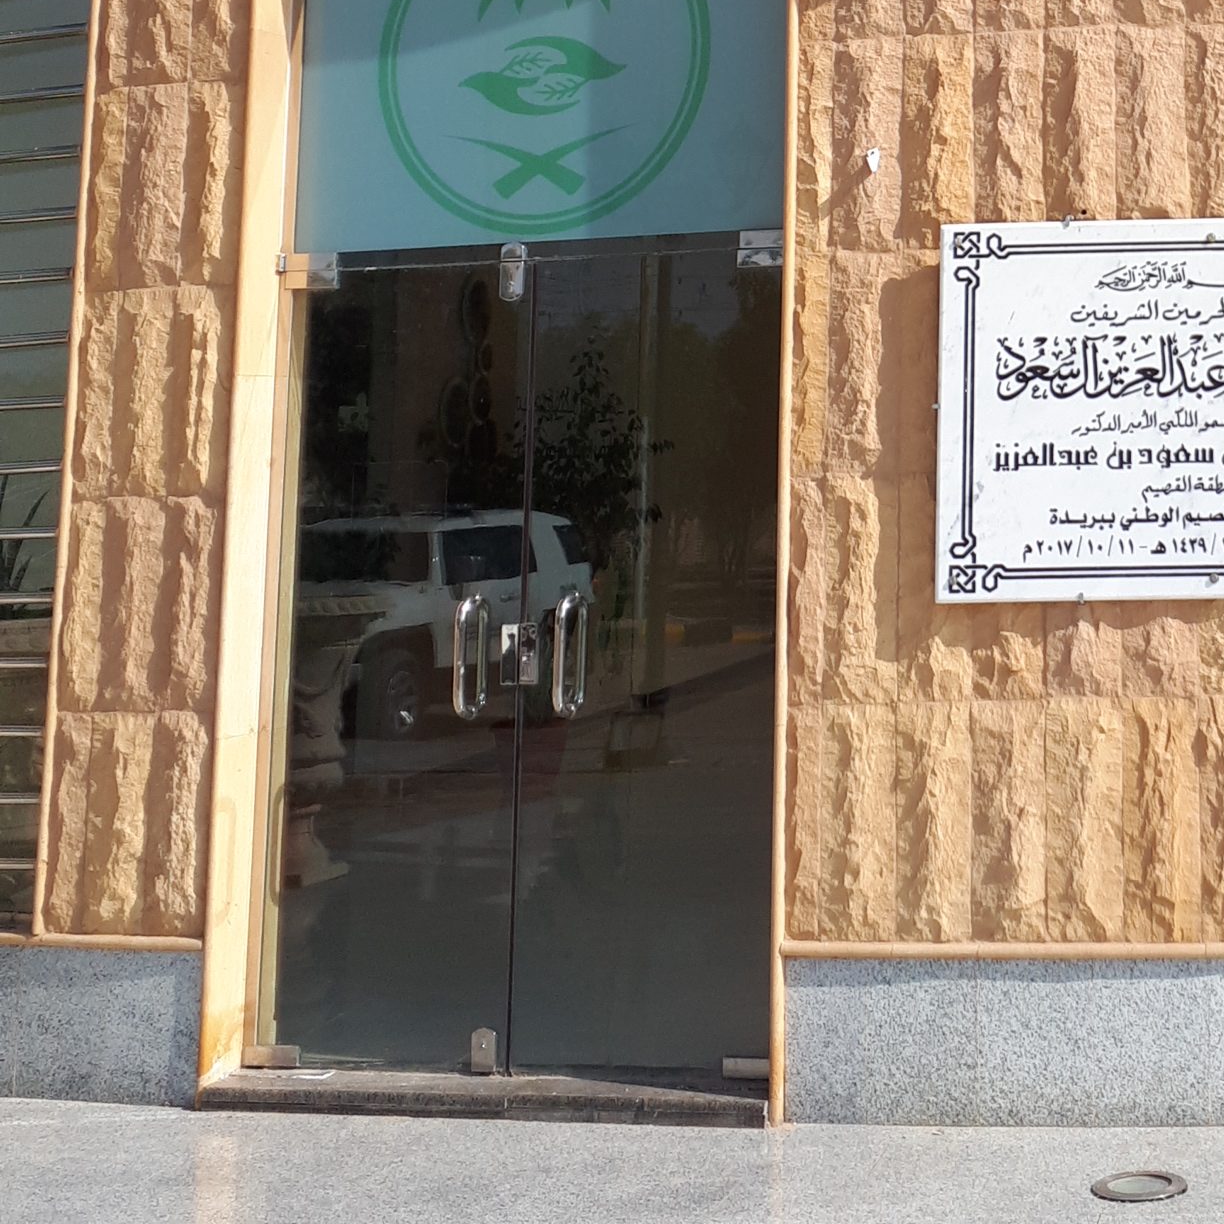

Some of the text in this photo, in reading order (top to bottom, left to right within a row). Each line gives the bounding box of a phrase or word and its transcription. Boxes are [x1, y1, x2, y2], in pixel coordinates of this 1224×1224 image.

[1070, 298, 1159, 327] الشريفين
[1106, 441, 1132, 470] بن
[1138, 442, 1214, 469] سعود
[1141, 474, 1192, 503] القصيم
[1048, 506, 1116, 530] ببريدة
[1120, 505, 1179, 530] الوطني
